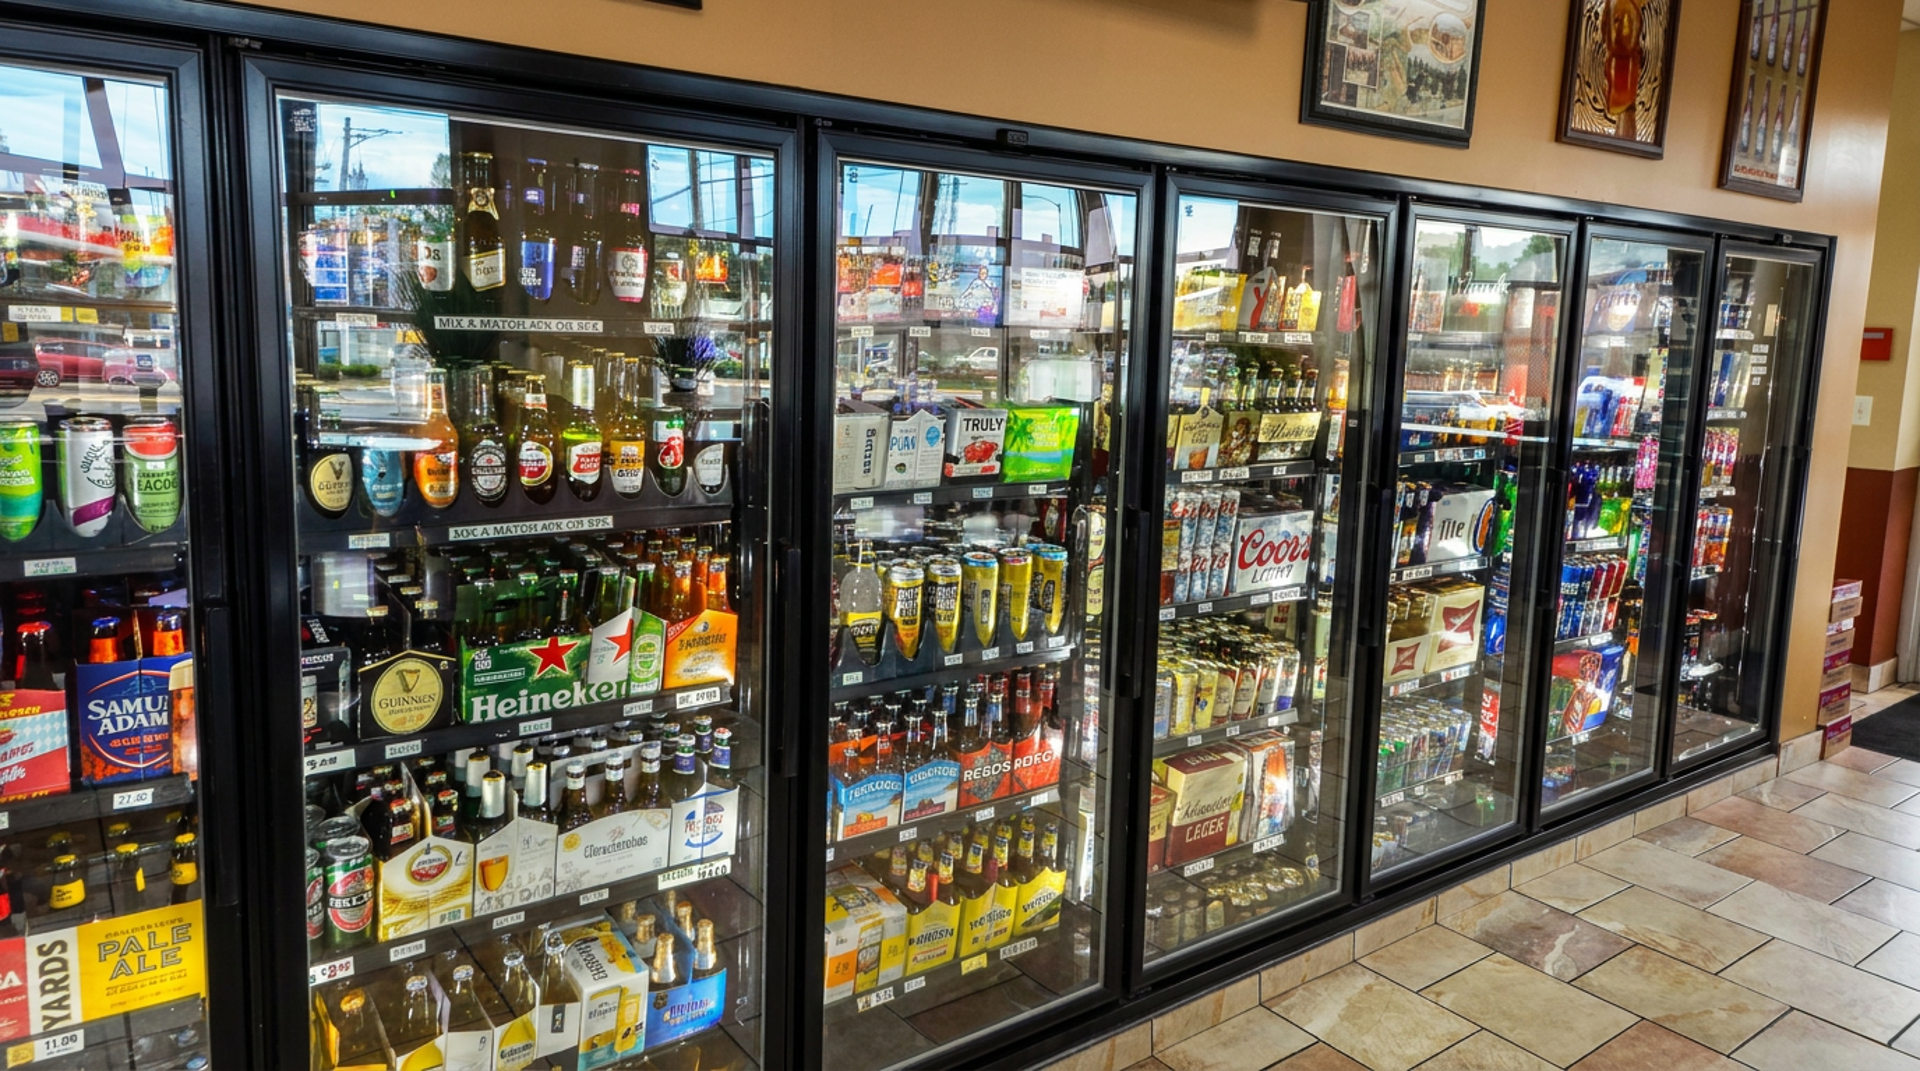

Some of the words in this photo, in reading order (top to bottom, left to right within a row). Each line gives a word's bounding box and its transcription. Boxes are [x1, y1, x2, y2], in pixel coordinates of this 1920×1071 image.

[963, 417, 1004, 432] TRULY
[98, 923, 192, 962] PALE
[109, 947, 182, 981] ALE
[36, 939, 71, 1032] YARDS
